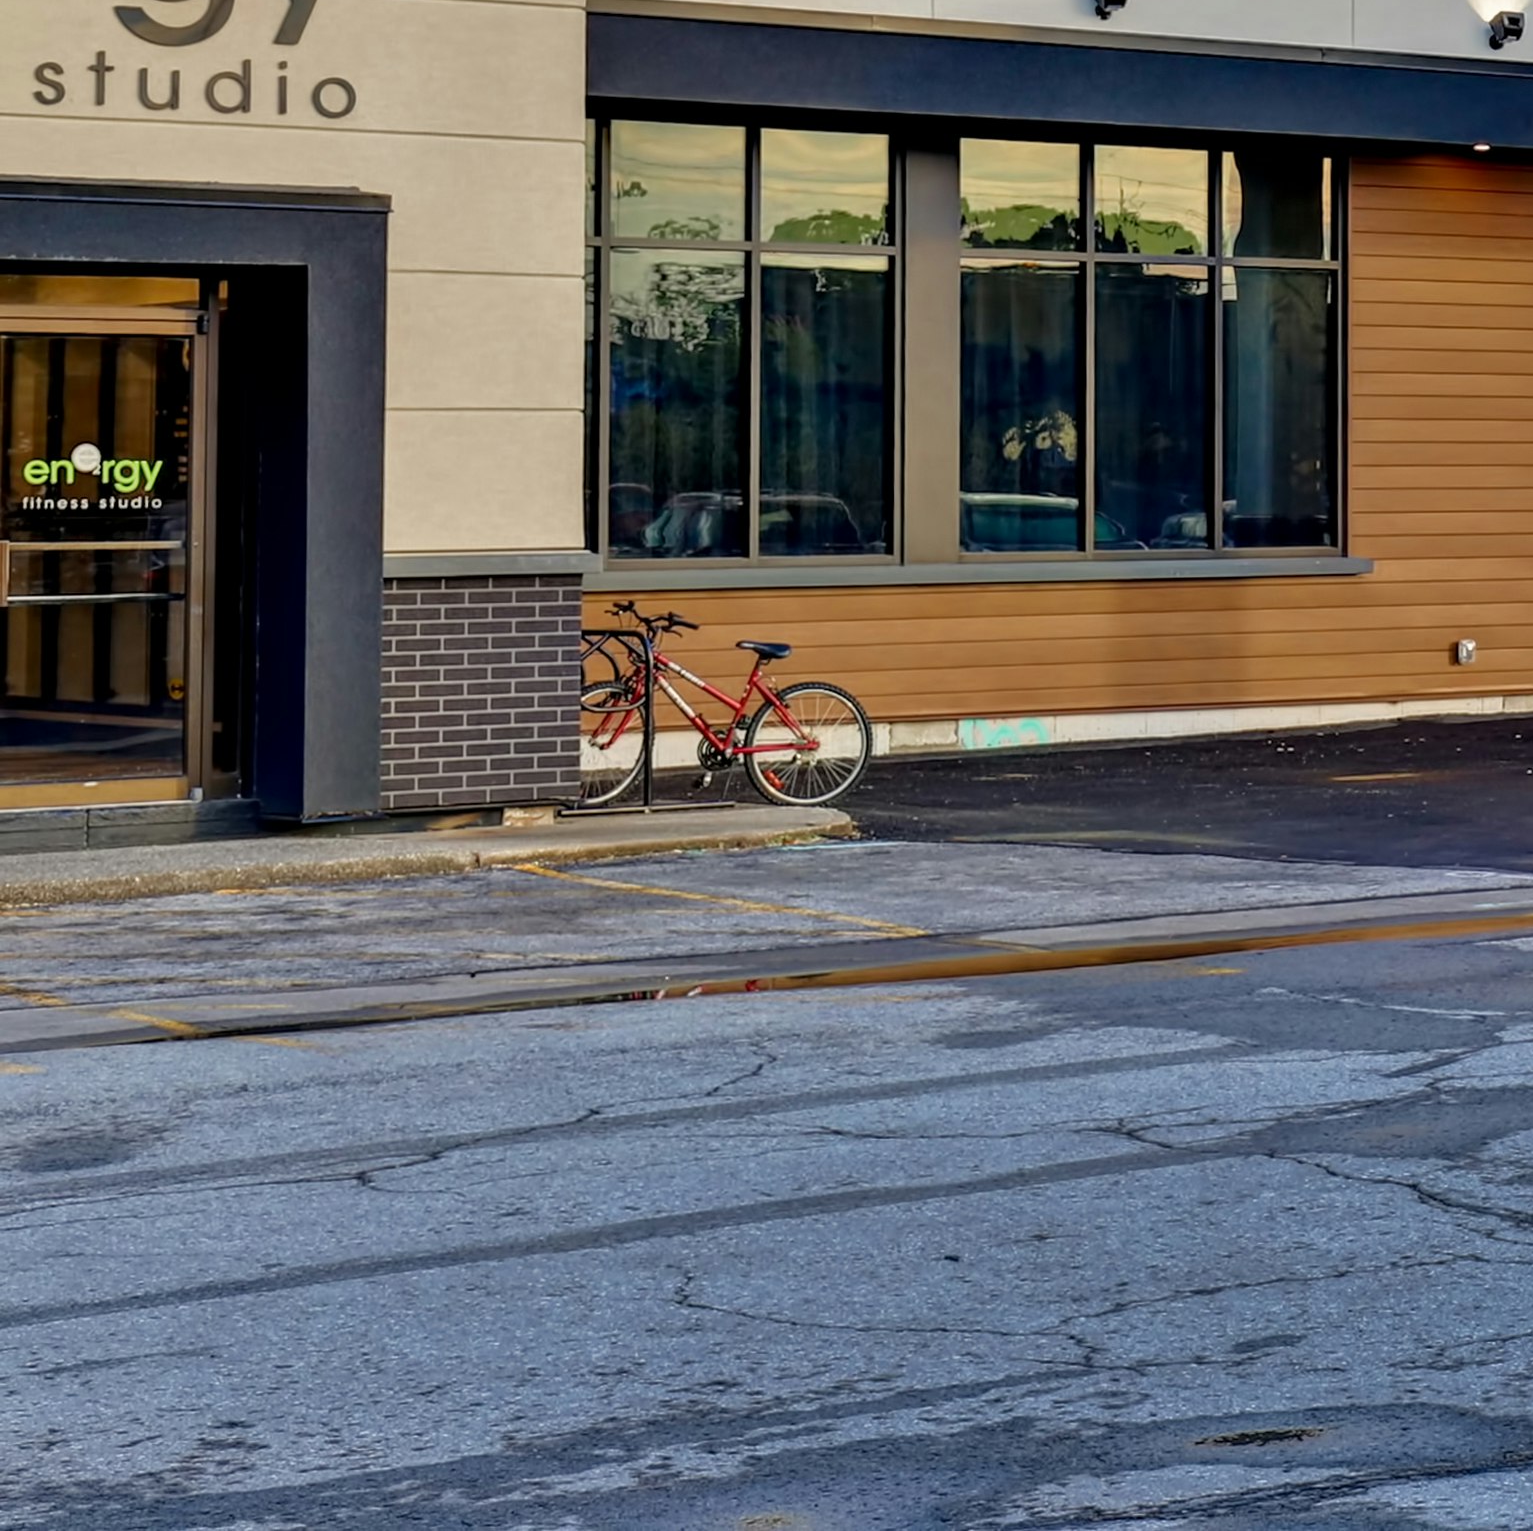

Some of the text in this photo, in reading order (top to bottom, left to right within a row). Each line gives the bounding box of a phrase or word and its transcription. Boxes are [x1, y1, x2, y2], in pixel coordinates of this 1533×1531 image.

[33, 51, 357, 119] studio
[22, 495, 163, 511] fitness studio
